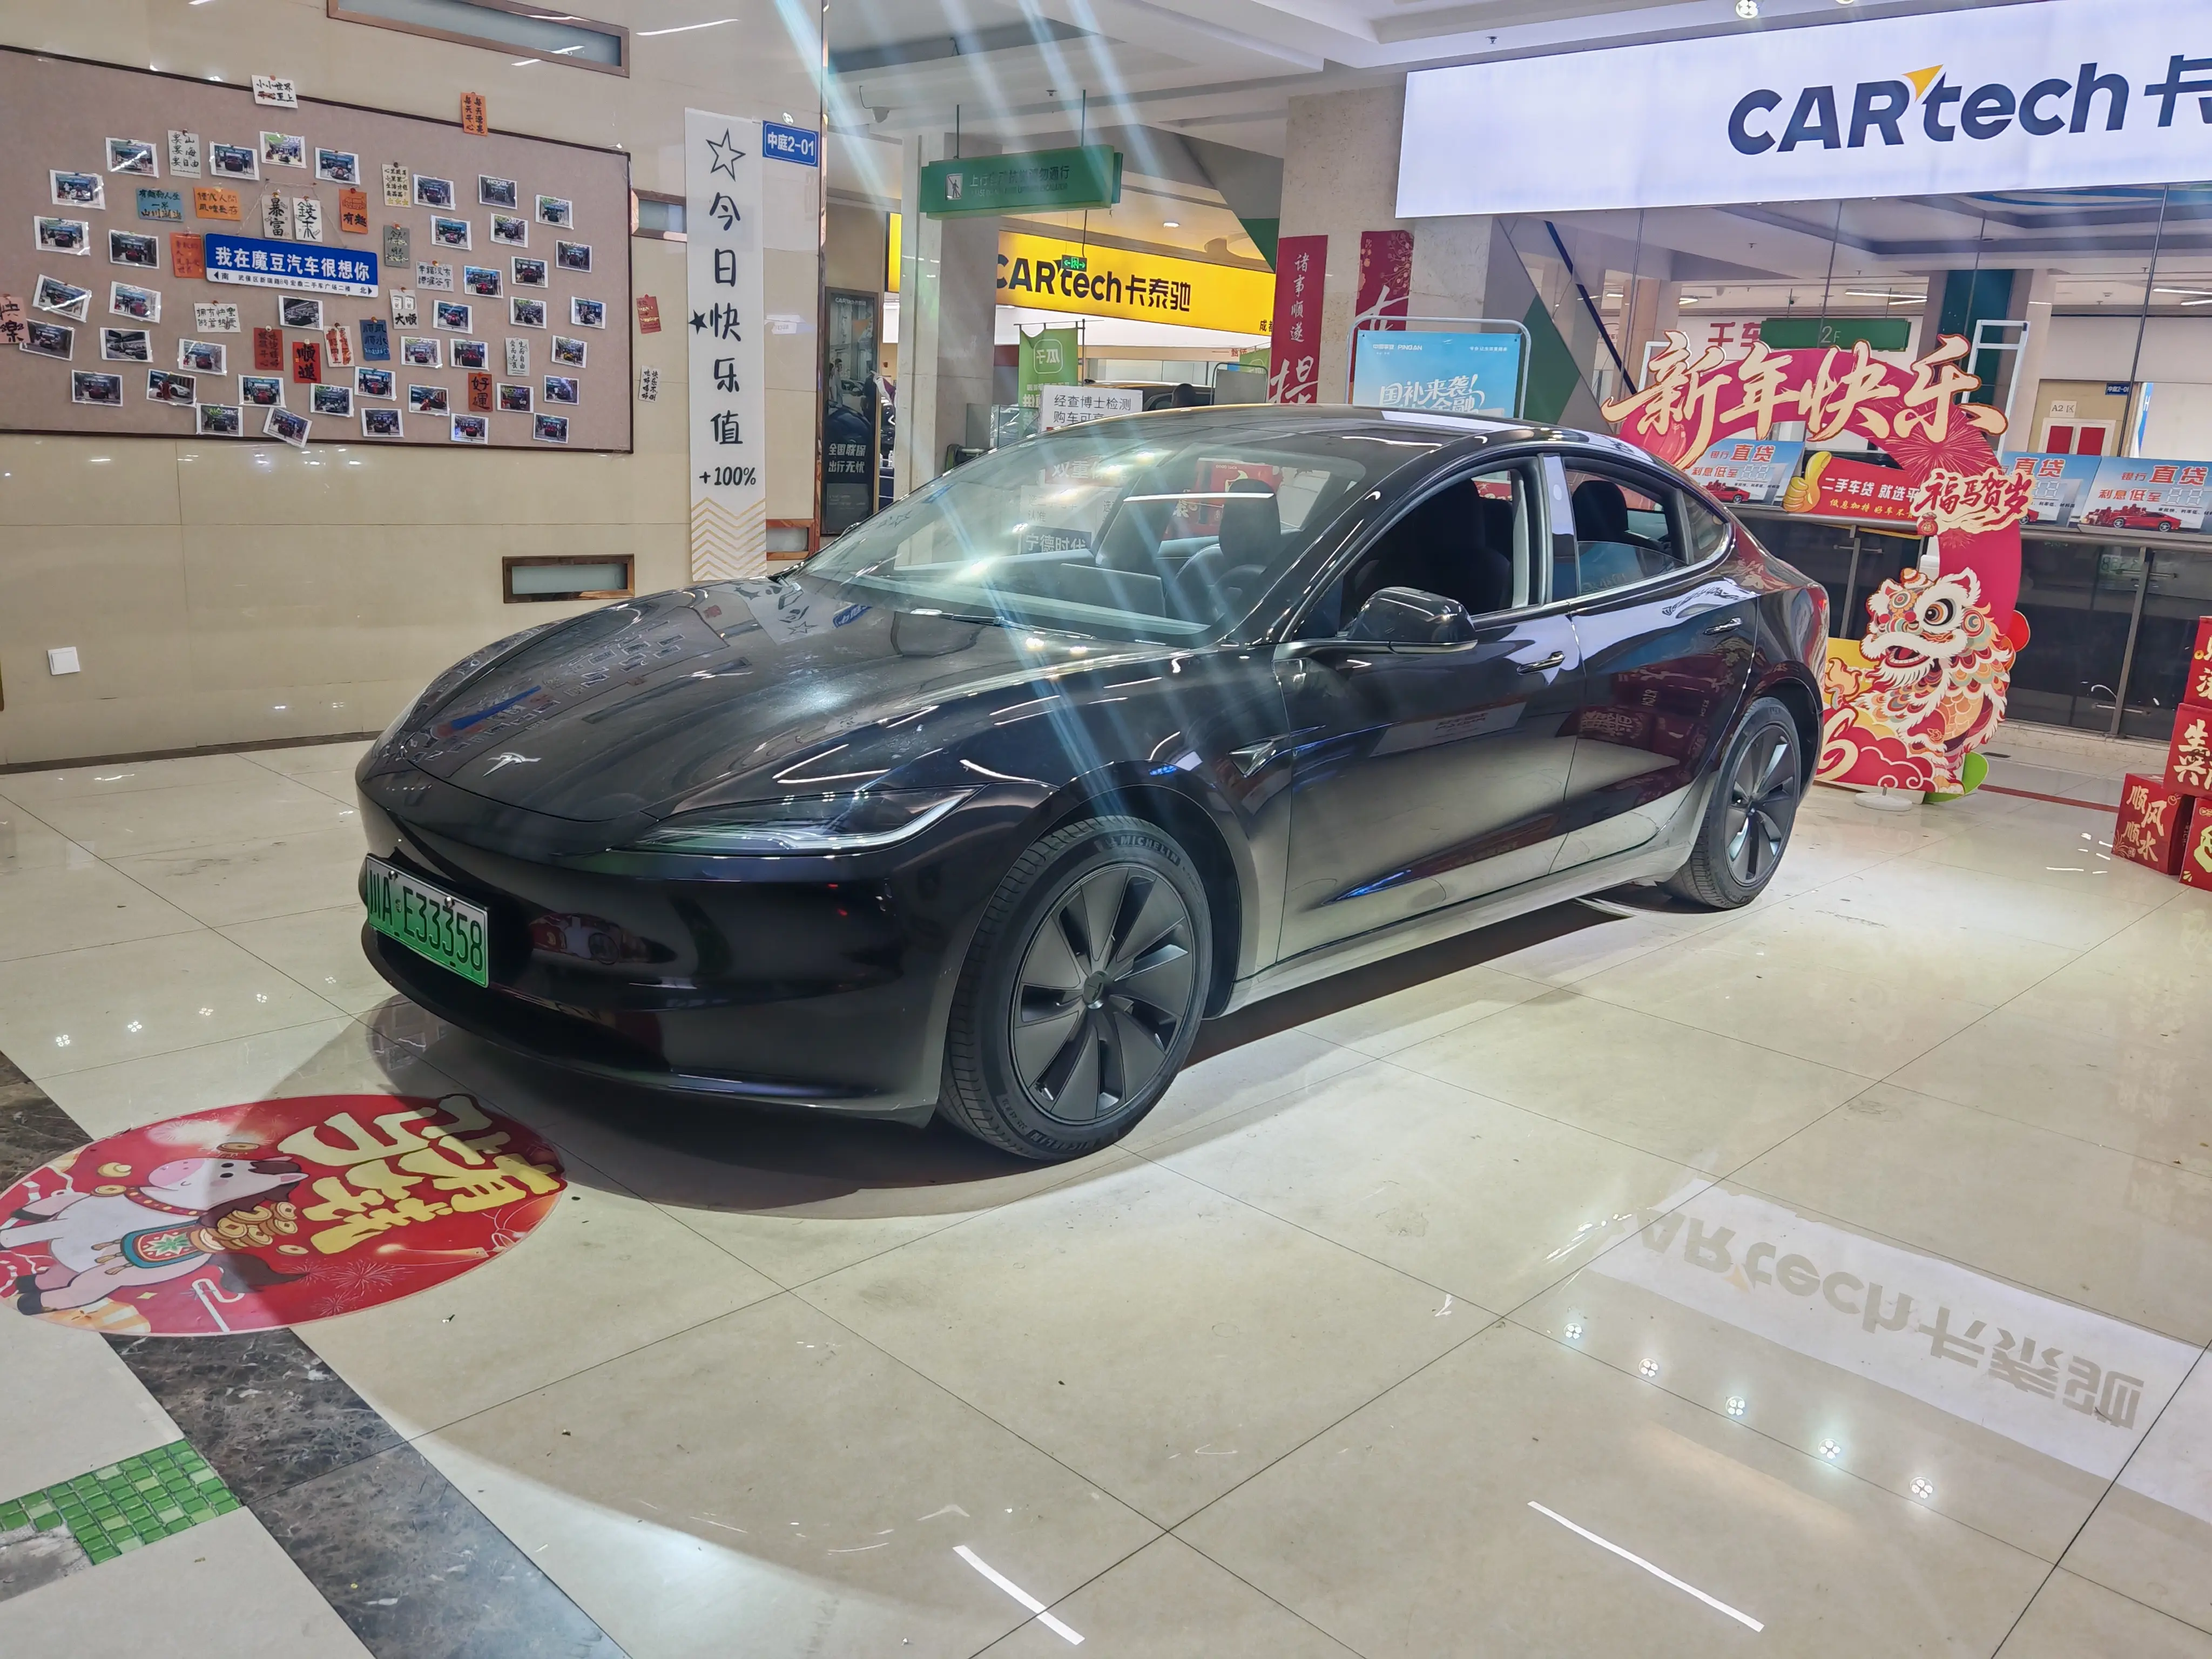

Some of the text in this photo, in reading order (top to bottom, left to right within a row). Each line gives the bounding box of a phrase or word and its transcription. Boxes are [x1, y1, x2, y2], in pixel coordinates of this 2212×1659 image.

[1728, 63, 2129, 155] CARtech
[767, 131, 814, 157] 中庭2-01
[215, 246, 370, 281] 我在魔豆汽车很想你
[221, 272, 230, 280] 南
[360, 286, 368, 294] 北
[1125, 274, 1191, 312] 卡泰驰
[1290, 253, 1310, 342] 诸事顺遂
[709, 192, 743, 445] 今日快乐值
[1820, 325, 1841, 344] 2F
[1054, 394, 1132, 411] 经查博士检测
[1601, 331, 2008, 470] 新年快乐
[828, 443, 867, 457] 全国联保
[1710, 443, 1776, 463] 银行直贷
[699, 466, 757, 487] +100%
[828, 460, 865, 474] 出行无忧
[1691, 465, 1739, 478] 利息低至
[2121, 465, 2208, 485] 银行直贷
[1822, 477, 1875, 497] 二手车贷
[2098, 488, 2162, 502] 利息低至
